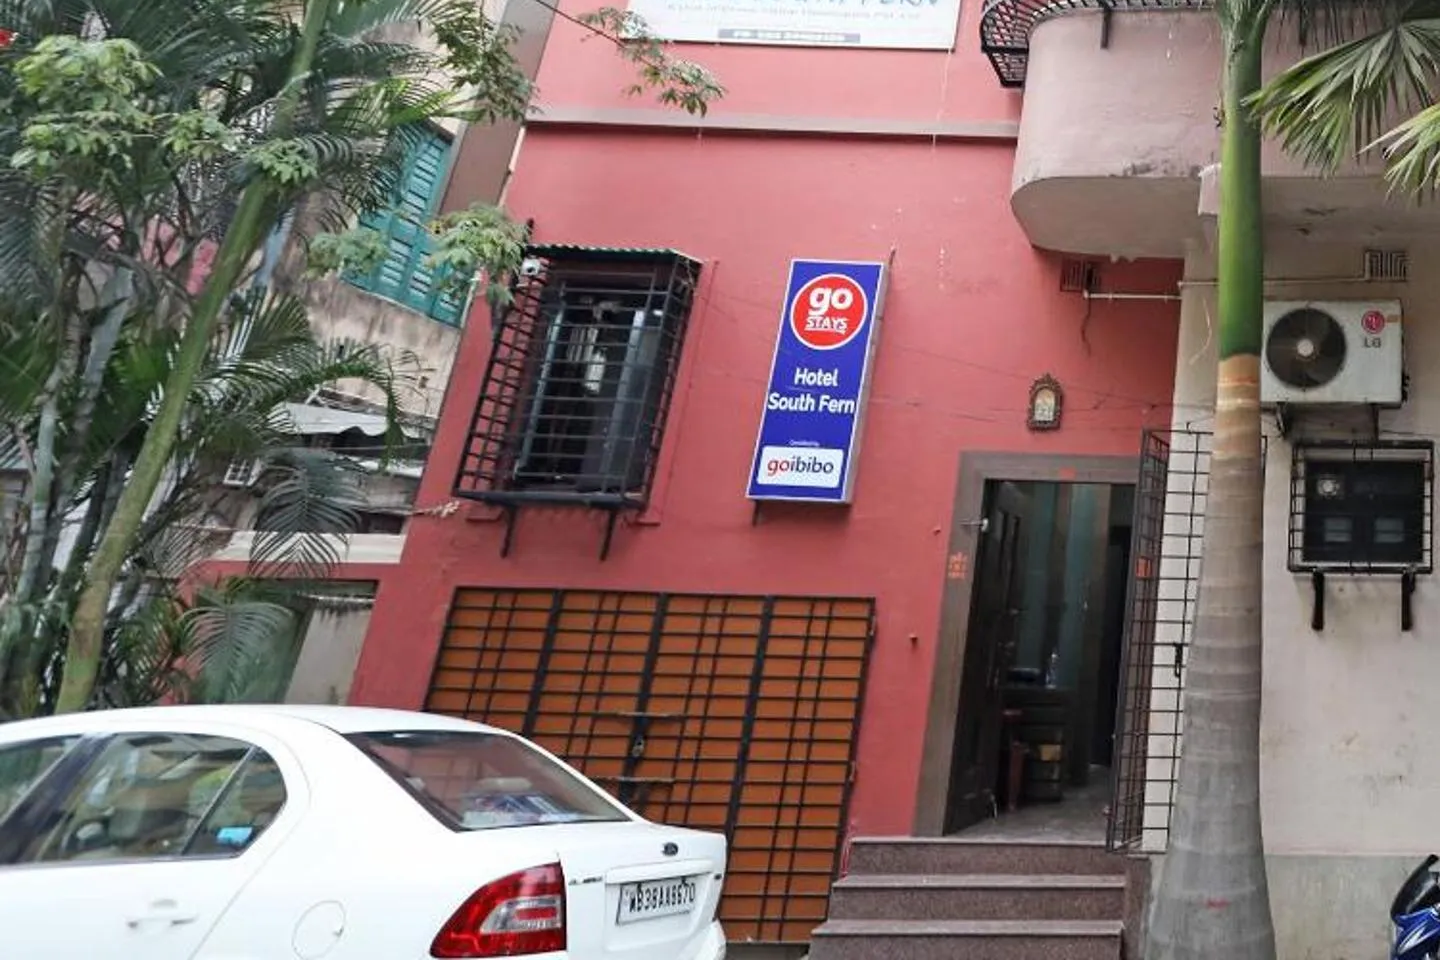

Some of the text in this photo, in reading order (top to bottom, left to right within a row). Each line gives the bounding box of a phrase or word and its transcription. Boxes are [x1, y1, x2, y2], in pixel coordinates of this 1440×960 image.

[808, 287, 853, 315] go
[805, 316, 848, 332] STAYS
[1363, 336, 1382, 348] LG
[794, 367, 838, 387] Hotel
[767, 391, 855, 414] South Fern
[767, 456, 834, 476] goibibo
